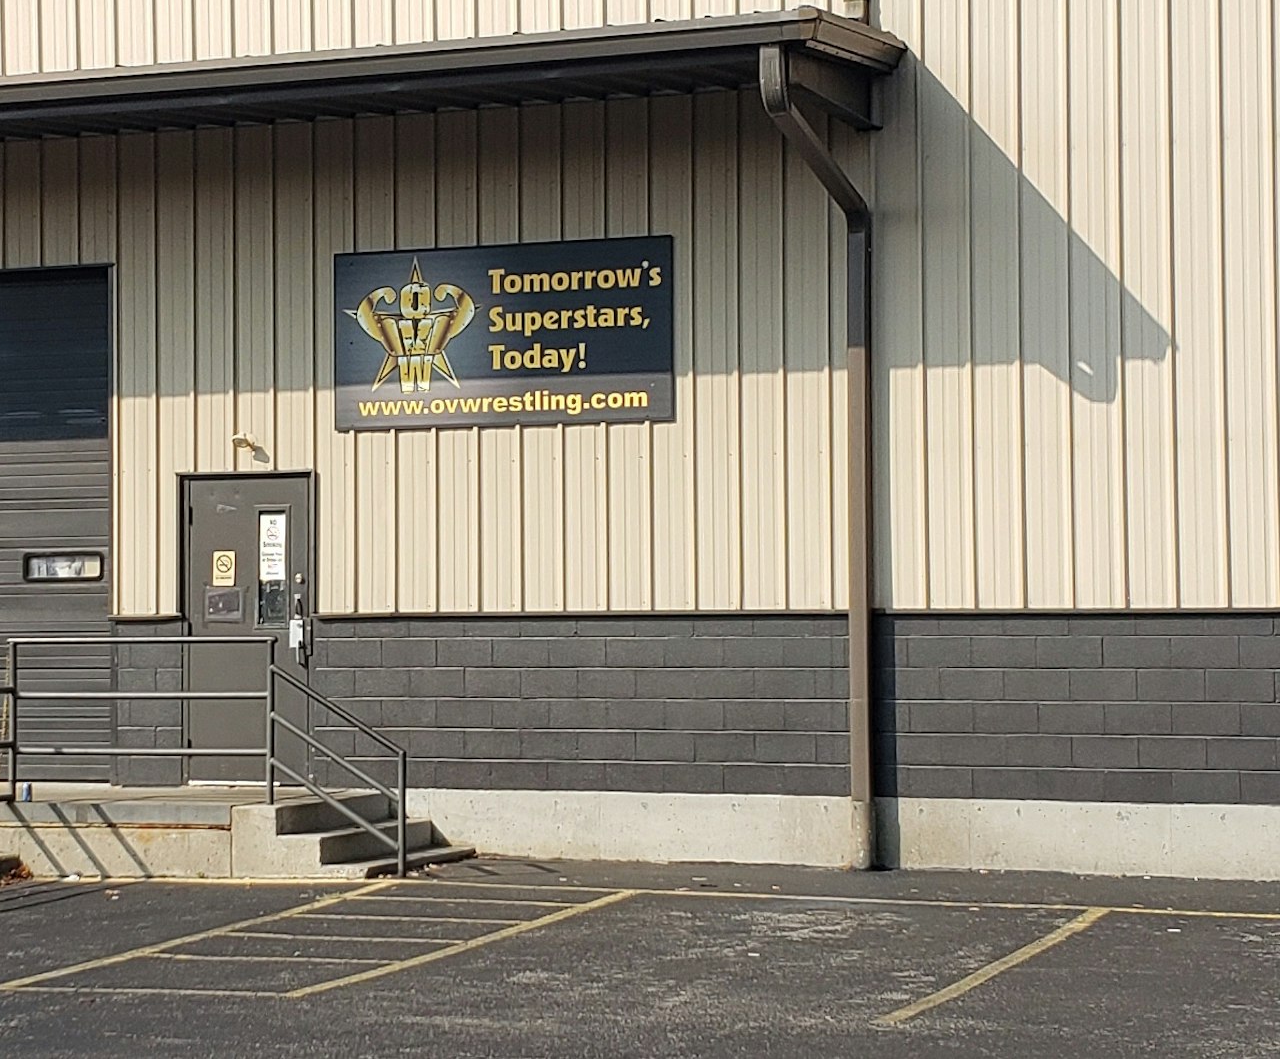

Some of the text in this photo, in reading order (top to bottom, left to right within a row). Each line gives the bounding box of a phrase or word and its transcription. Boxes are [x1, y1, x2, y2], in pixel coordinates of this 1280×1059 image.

[488, 261, 662, 293] Tomorrow's
[489, 305, 650, 337] Superstars,
[489, 343, 587, 372] Today!
[359, 390, 648, 416] www.ovwrestling.com
